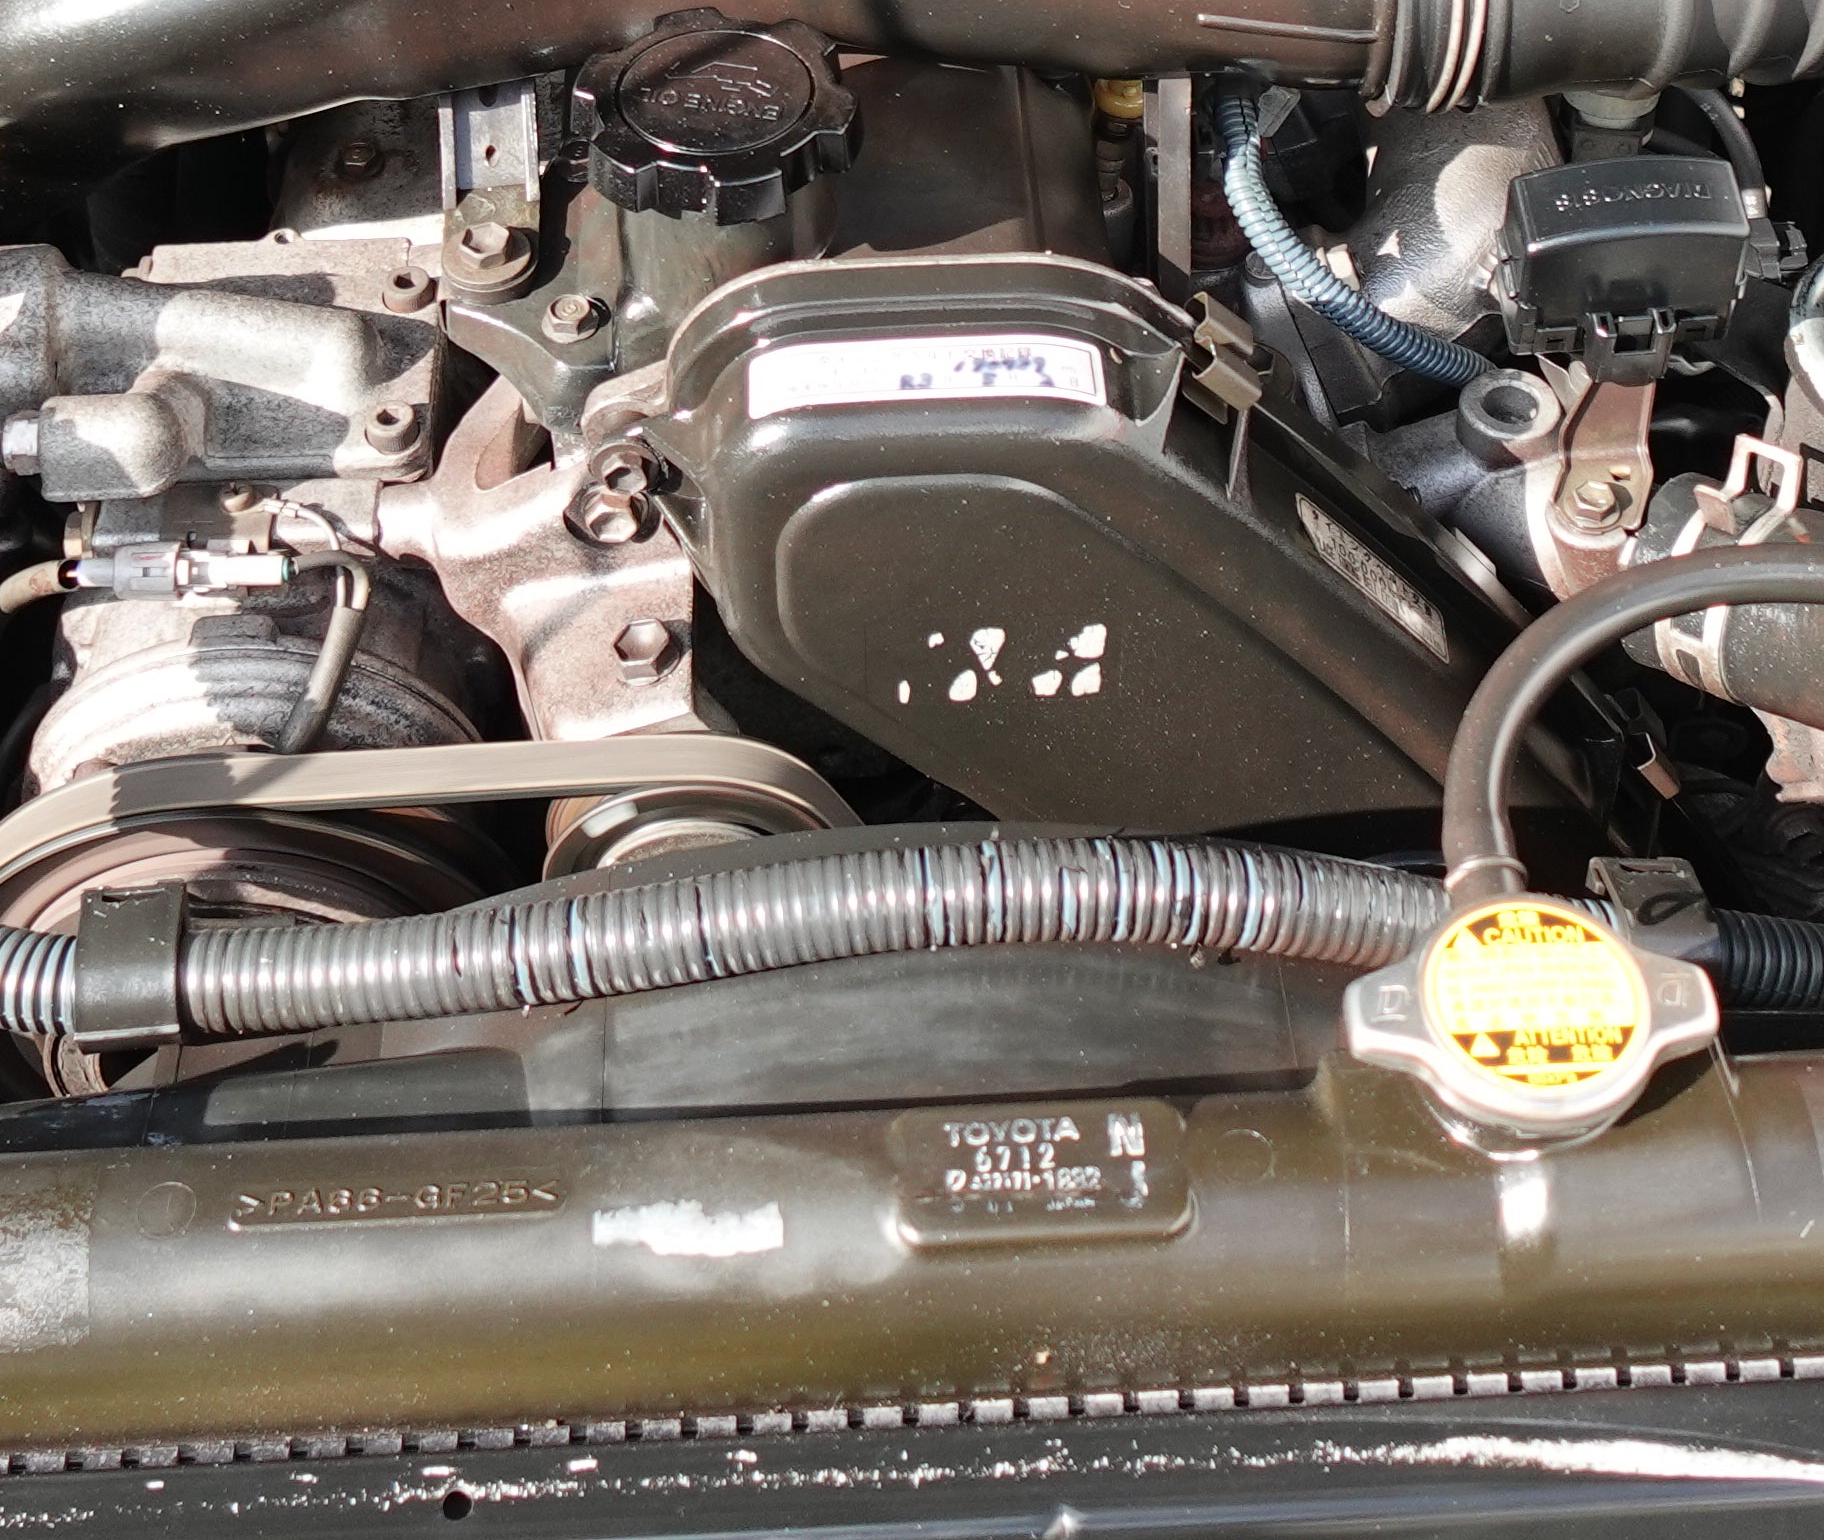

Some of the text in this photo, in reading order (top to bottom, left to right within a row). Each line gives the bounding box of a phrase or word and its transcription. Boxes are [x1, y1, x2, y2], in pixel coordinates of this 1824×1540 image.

[1482, 924, 1586, 945] CAUTION
[1514, 1027, 1623, 1047] ATTENTION
[943, 1115, 1081, 1148] TOYOTA
[973, 1142, 1056, 1172] 6712
